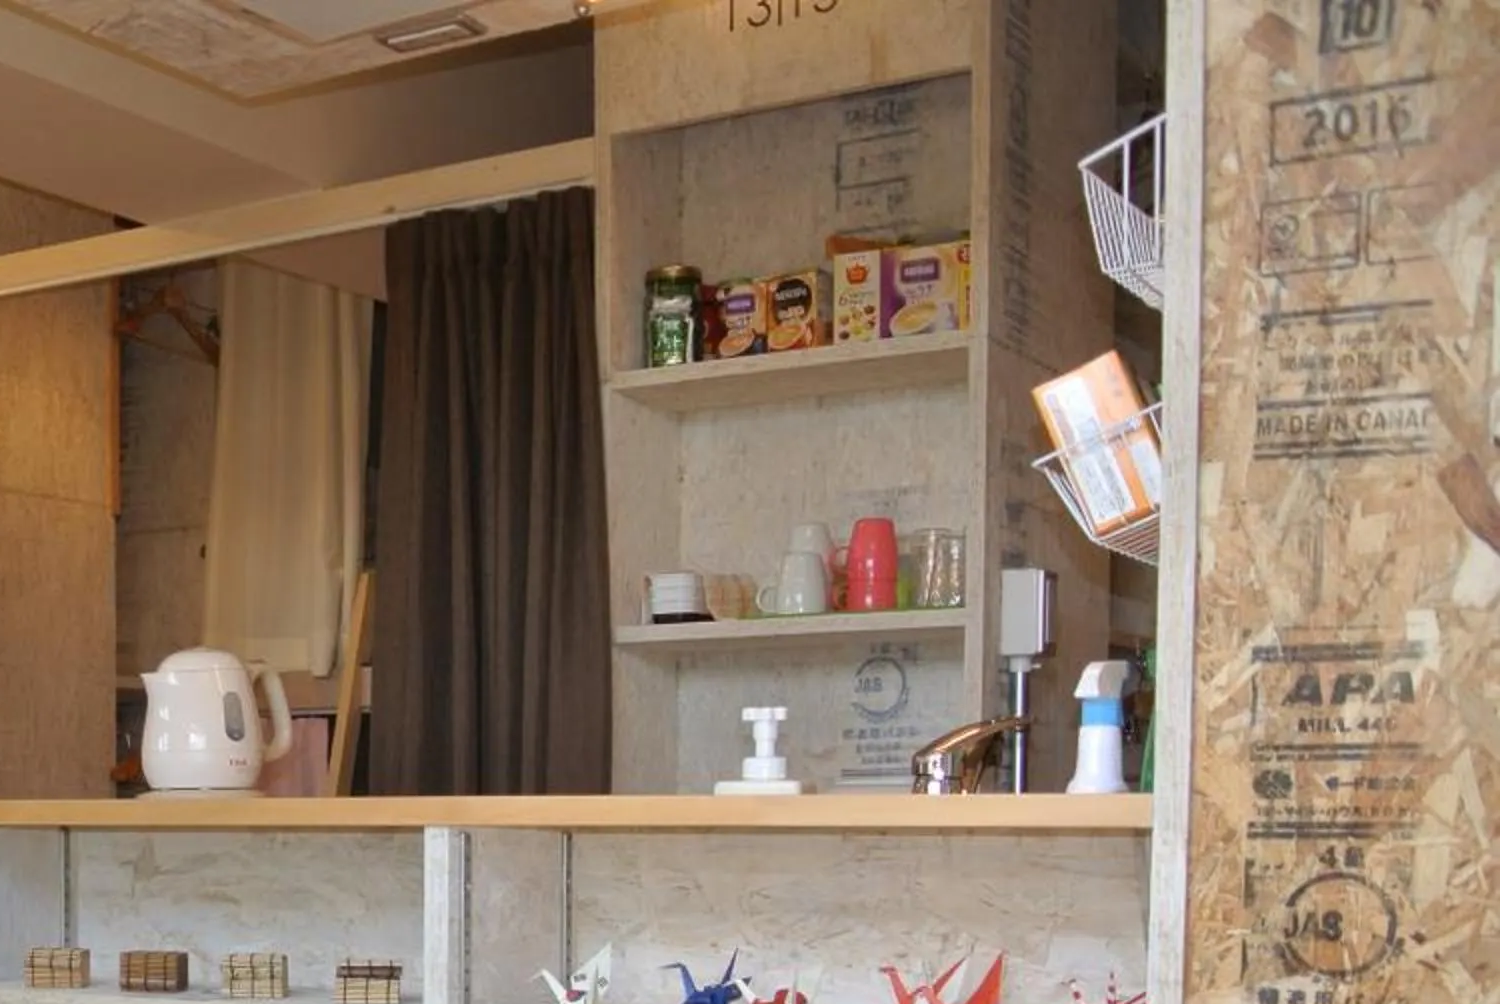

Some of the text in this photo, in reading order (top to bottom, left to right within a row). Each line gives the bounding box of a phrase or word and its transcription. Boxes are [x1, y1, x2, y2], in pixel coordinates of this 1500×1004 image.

[1327, 412, 1349, 432] IN
[1280, 670, 1416, 706] APA
[1284, 910, 1344, 942] JAS
